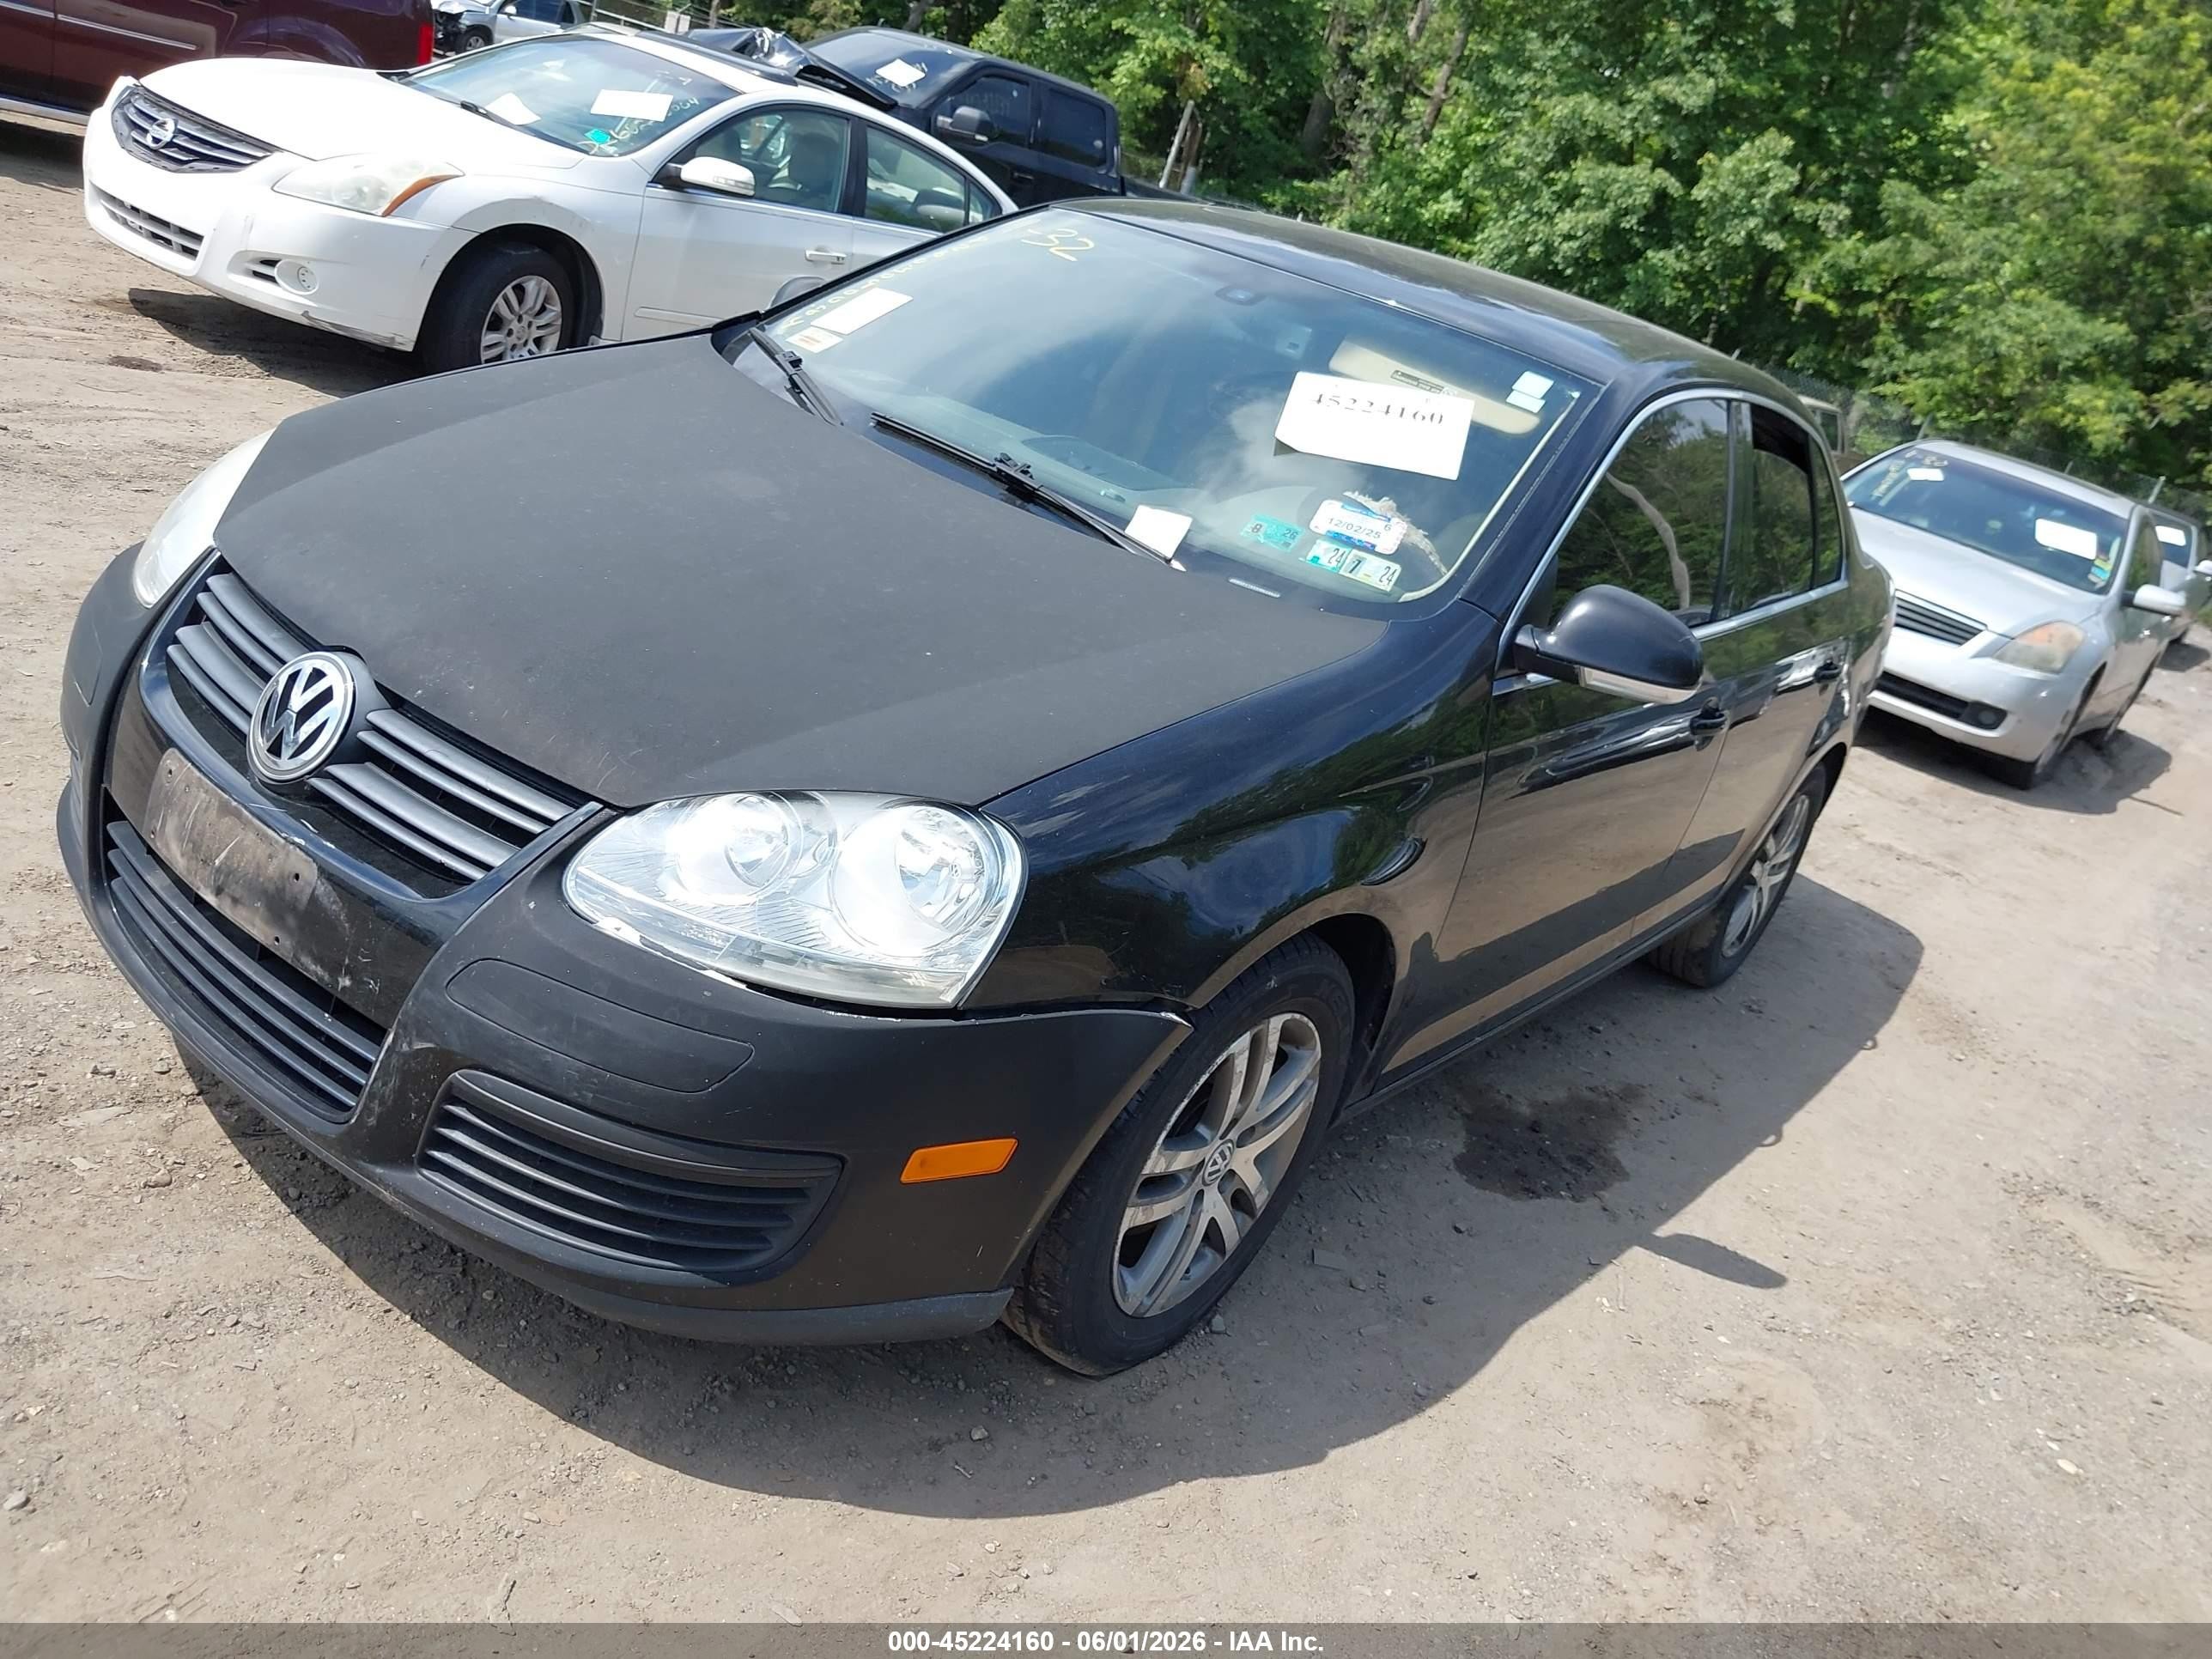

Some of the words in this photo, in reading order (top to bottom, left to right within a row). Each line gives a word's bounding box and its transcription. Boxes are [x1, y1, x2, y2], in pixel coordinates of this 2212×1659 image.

[1328, 517, 1381, 539] 12/02/25
[1328, 548, 1346, 566] 24
[1379, 566, 1397, 586] 24
